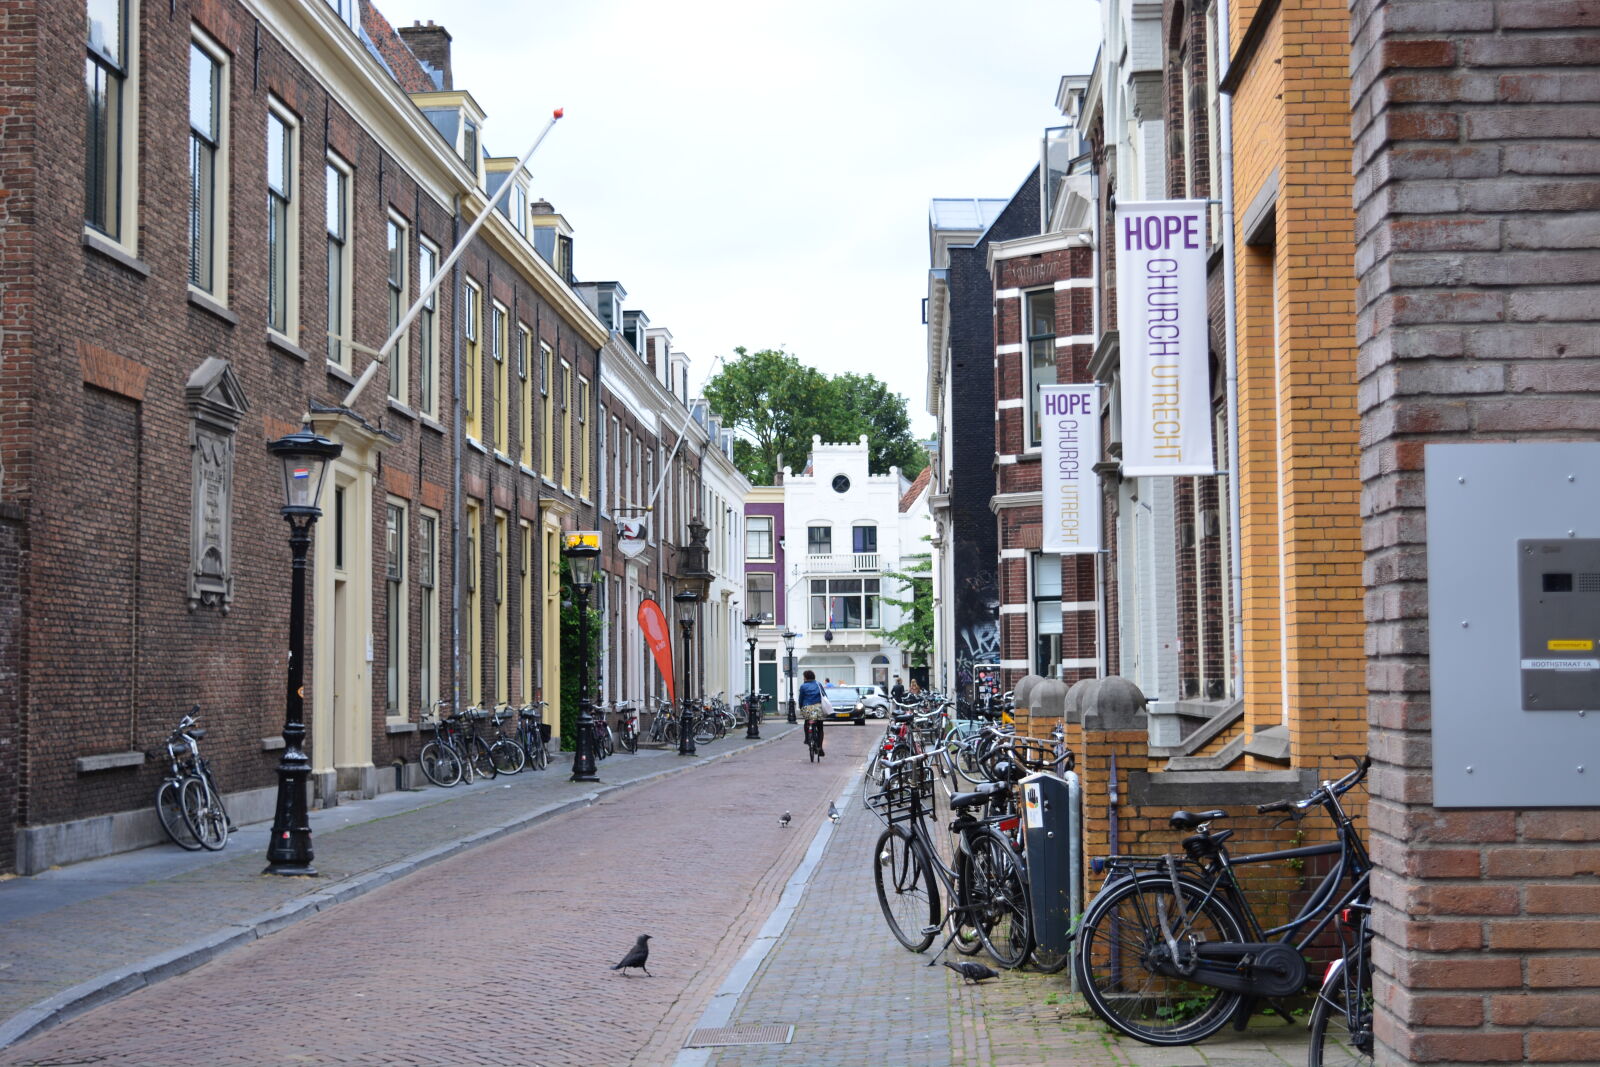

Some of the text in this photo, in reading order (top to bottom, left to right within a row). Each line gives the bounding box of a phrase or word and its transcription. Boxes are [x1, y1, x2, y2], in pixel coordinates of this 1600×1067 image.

[1124, 215, 1199, 251] HOPE
[1146, 258, 1182, 462] CHURCH UTRECHT
[1045, 393, 1091, 416] HOPE
[1058, 419, 1080, 545] CHURCH UTRECHT
